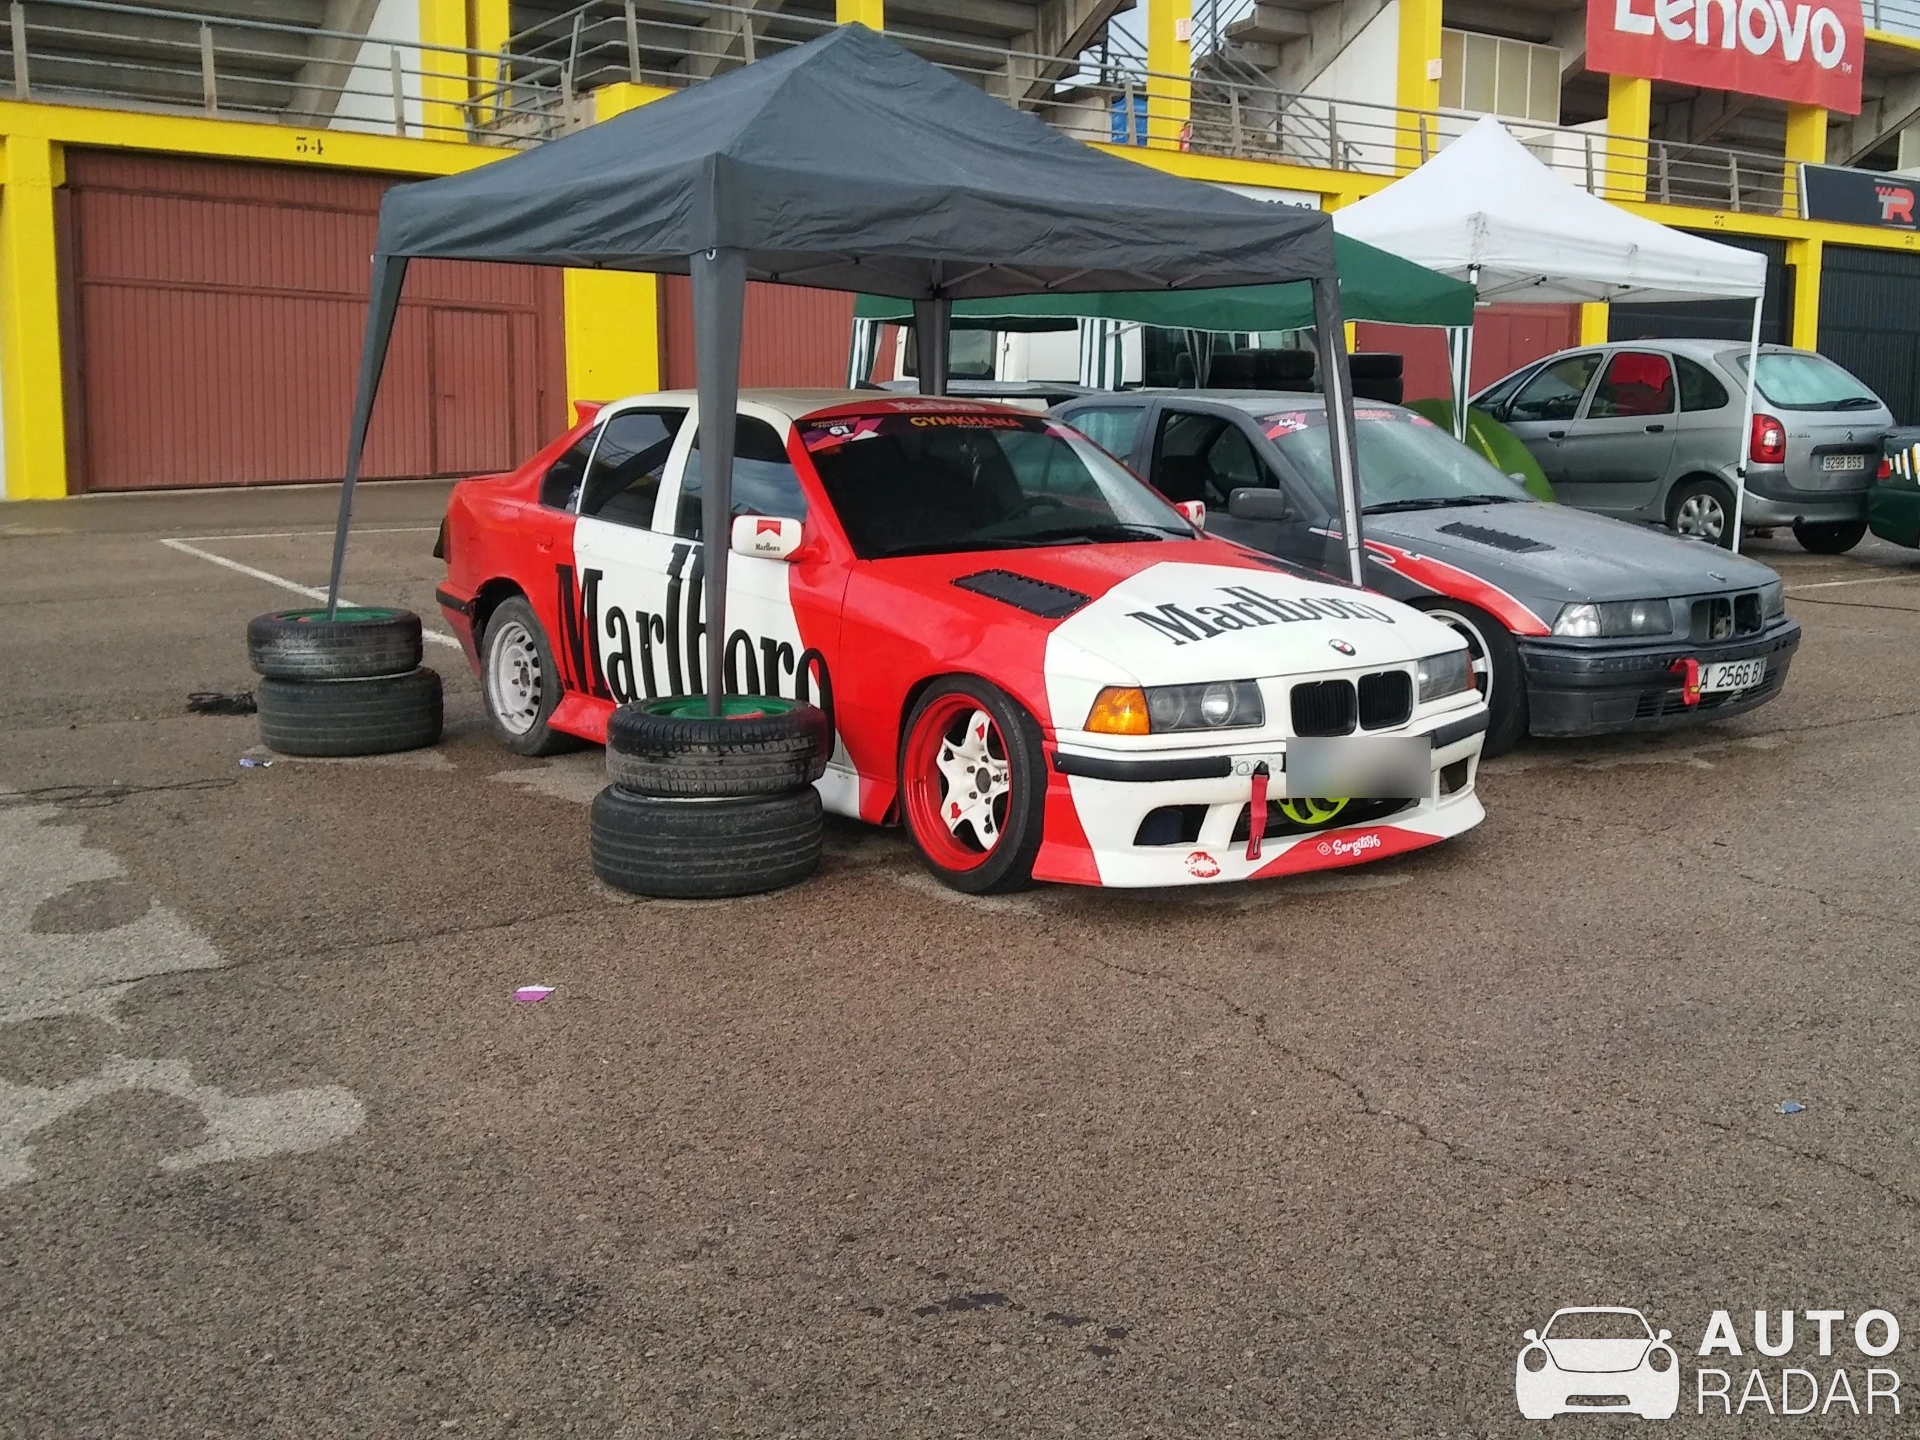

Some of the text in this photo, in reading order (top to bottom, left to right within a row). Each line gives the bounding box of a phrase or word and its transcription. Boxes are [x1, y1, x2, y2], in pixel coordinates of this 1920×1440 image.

[1614, 0, 1846, 69] Lenovo
[755, 542, 781, 552] Marlboro
[1124, 583, 1396, 646] Marlboro
[1699, 667, 1709, 689] A
[1716, 663, 1751, 688] 2566
